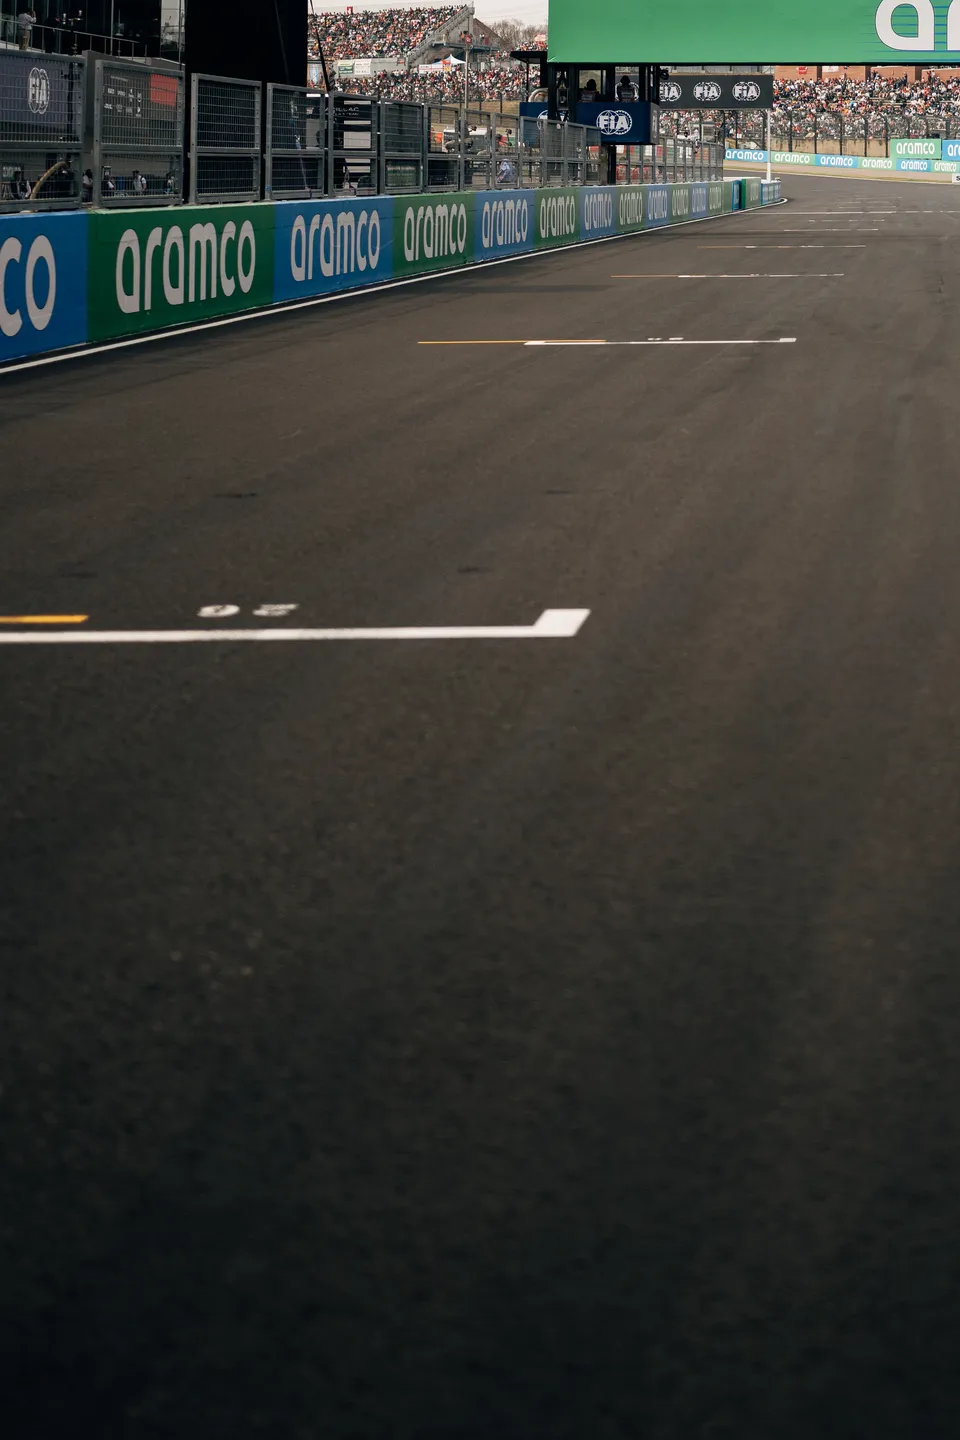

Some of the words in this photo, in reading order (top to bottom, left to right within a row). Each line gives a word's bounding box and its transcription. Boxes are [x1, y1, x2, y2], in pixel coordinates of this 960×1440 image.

[598, 113, 630, 132] FIA
[725, 149, 764, 161] aramco
[896, 141, 935, 155] aramco
[774, 153, 811, 164] aramco
[820, 155, 853, 167] aramco
[862, 158, 893, 169] aramco
[900, 160, 928, 171] aramco
[934, 162, 957, 173] aramco
[539, 195, 576, 239] aramco
[584, 192, 612, 230] aramco
[482, 198, 528, 249] aramco
[403, 203, 467, 262] aramco
[290, 209, 381, 282] aramco
[116, 219, 256, 314] aramco
